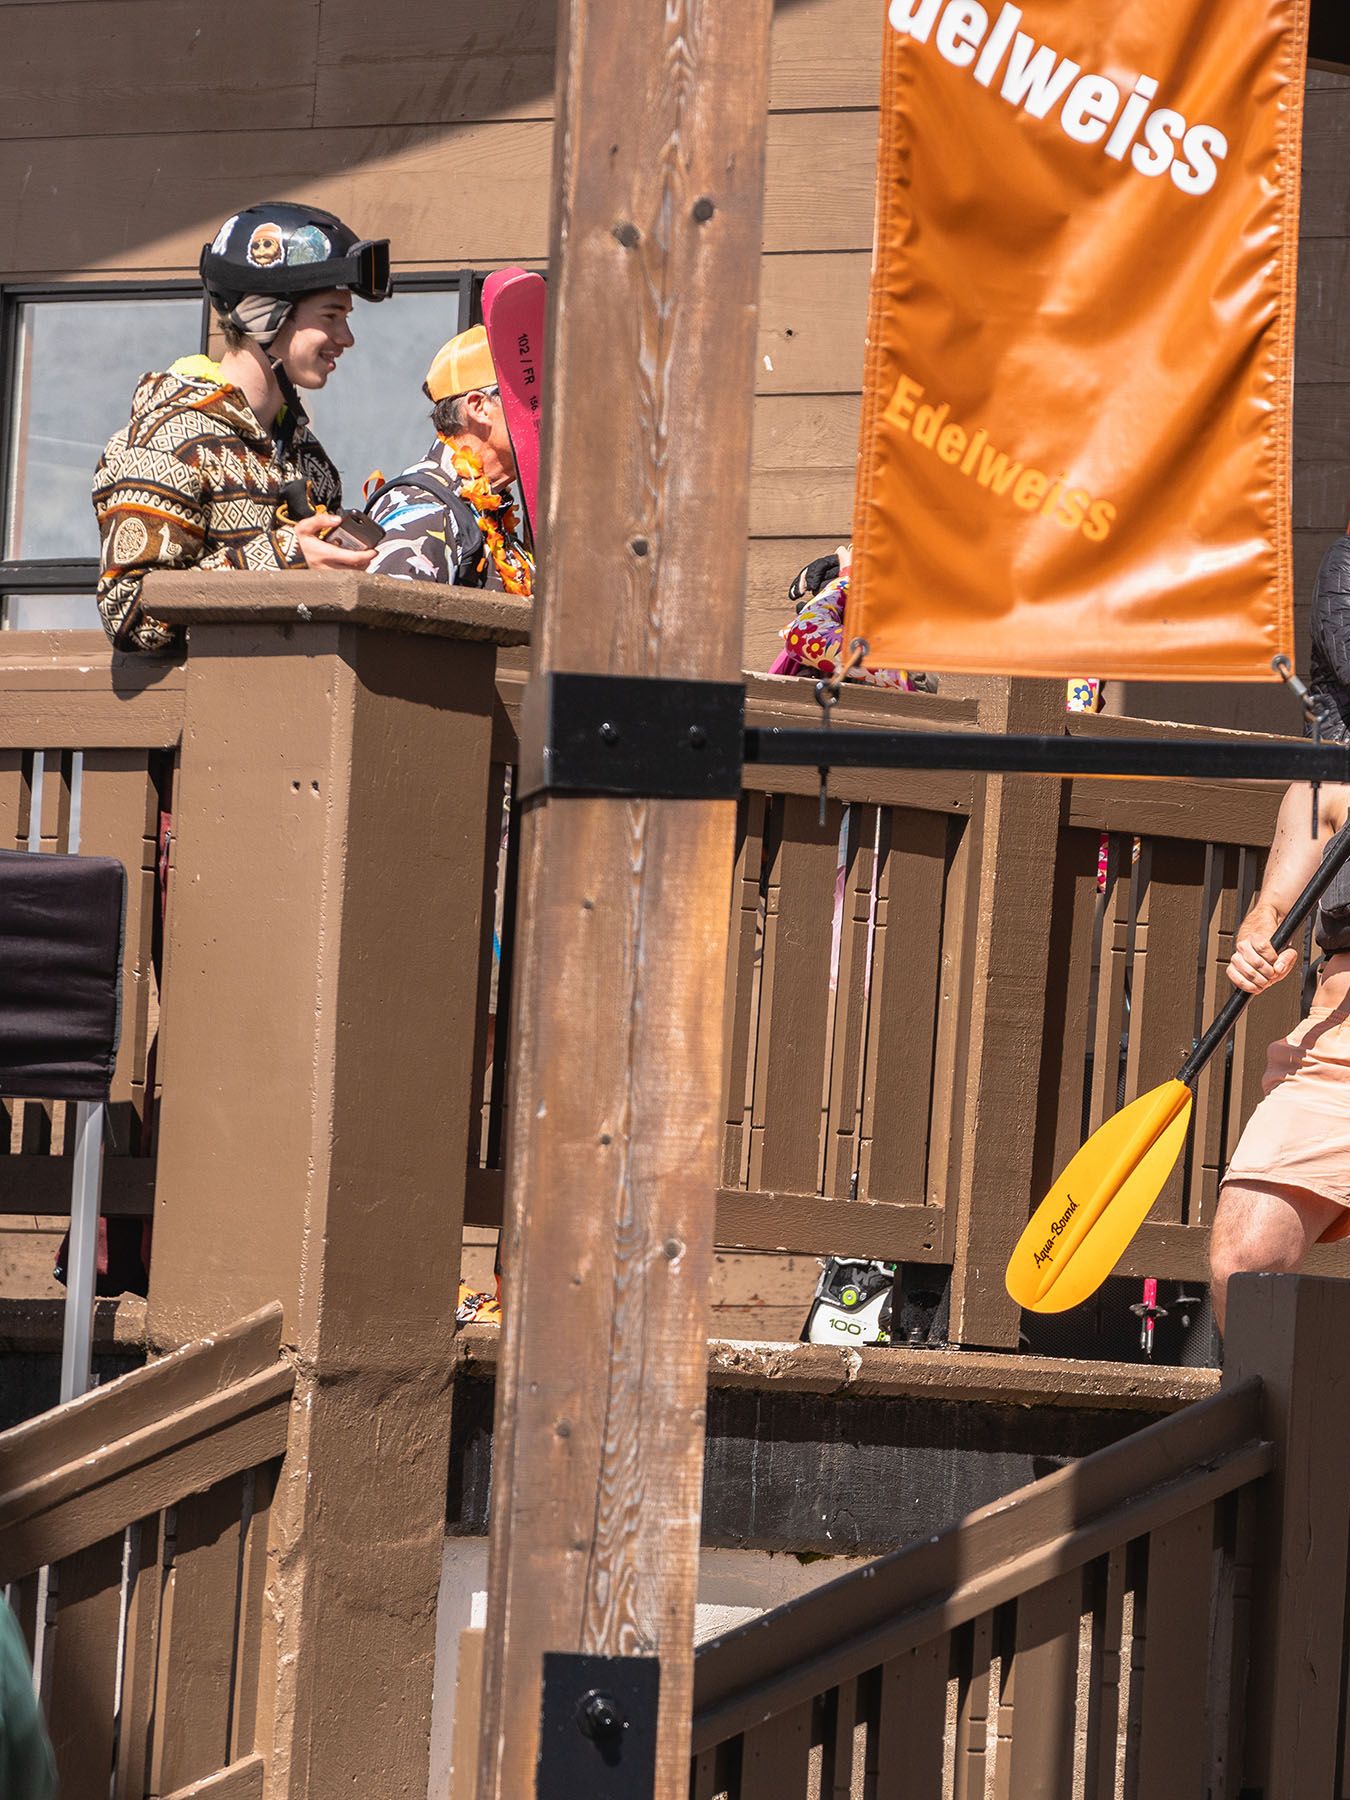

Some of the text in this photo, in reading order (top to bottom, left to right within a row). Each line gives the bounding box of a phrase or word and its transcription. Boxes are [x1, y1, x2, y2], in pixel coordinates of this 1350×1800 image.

[517, 333, 530, 356] 102
[523, 367, 536, 385] FR
[882, 373, 1117, 542] Edelweiss
[1033, 1193, 1079, 1269] Aqua-Bound
